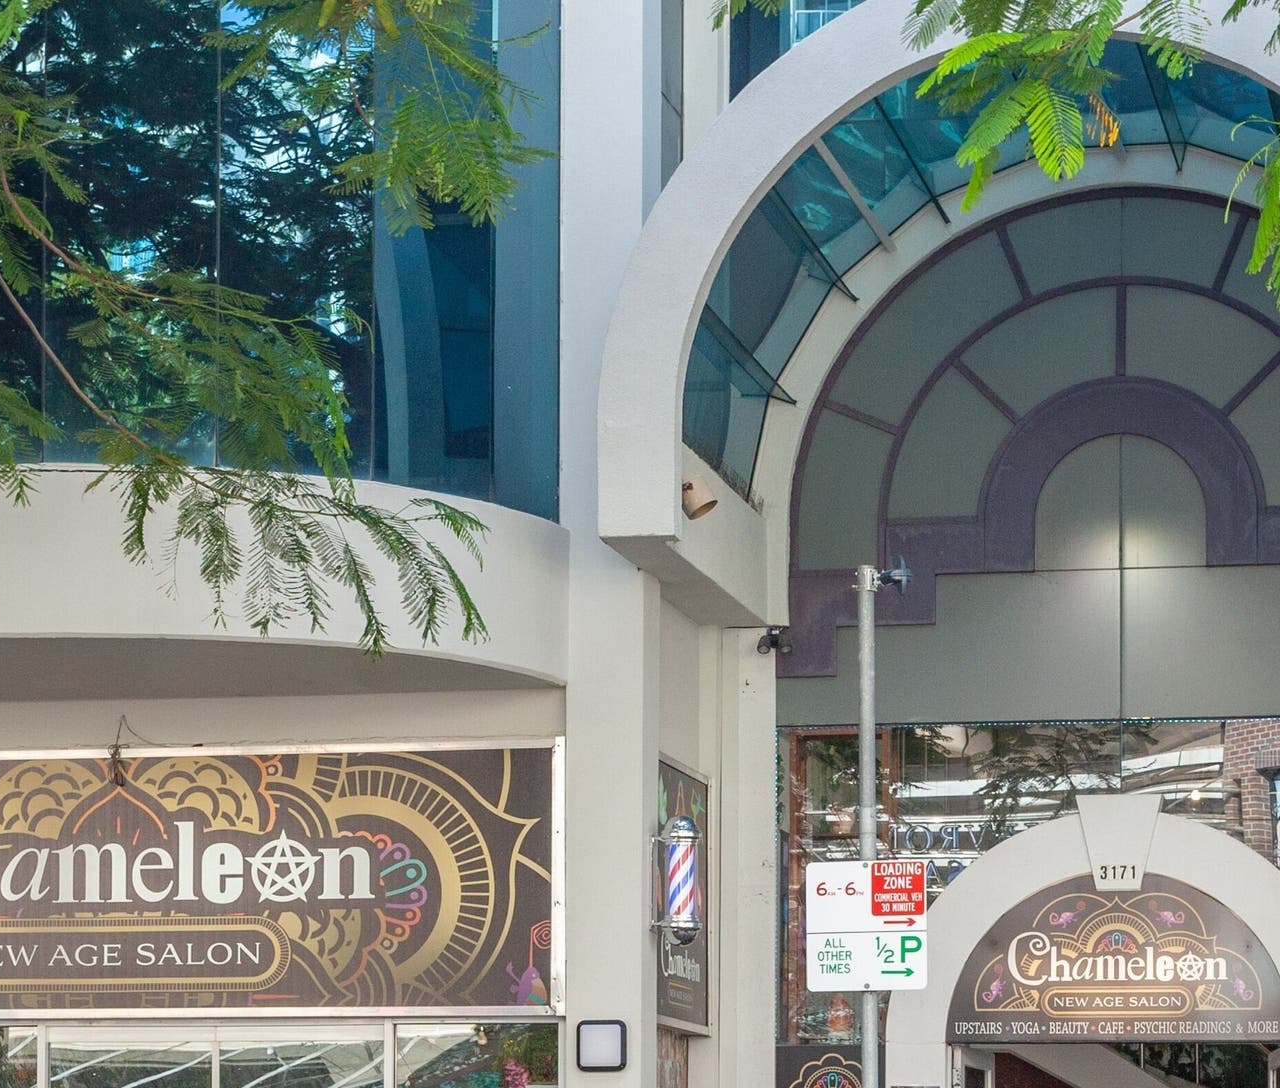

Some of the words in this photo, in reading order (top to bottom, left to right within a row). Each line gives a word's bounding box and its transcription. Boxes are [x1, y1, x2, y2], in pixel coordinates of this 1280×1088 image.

[874, 862, 923, 876] LOADING
[1100, 865, 1137, 880] 3171
[883, 876, 913, 889] ZONE
[874, 892, 909, 902] COMMERCIAL
[911, 892, 923, 902] VEH
[881, 902, 890, 912] 30
[892, 902, 916, 912] MINUTE
[824, 938, 846, 949] ALL
[900, 935, 922, 963] P
[47, 943, 122, 968] AGE
[136, 941, 263, 967] SALON
[817, 951, 853, 962] OTHER
[1007, 931, 1229, 986] Chameleon
[819, 963, 851, 974] TIMES
[1053, 996, 1090, 1009] NEW
[1092, 995, 1125, 1008] AGE
[1128, 995, 1182, 1008] SALON
[954, 1021, 1002, 1035] UPSTAIRS
[1011, 1021, 1040, 1035] YOGA
[1049, 1021, 1089, 1035] BEAUTY
[1098, 1021, 1125, 1035] CAFE
[1133, 1021, 1177, 1034] PSYCHIC
[1179, 1020, 1231, 1034] READINGS
[1235, 1022, 1244, 1034] &
[1247, 1020, 1279, 1034] MORE
